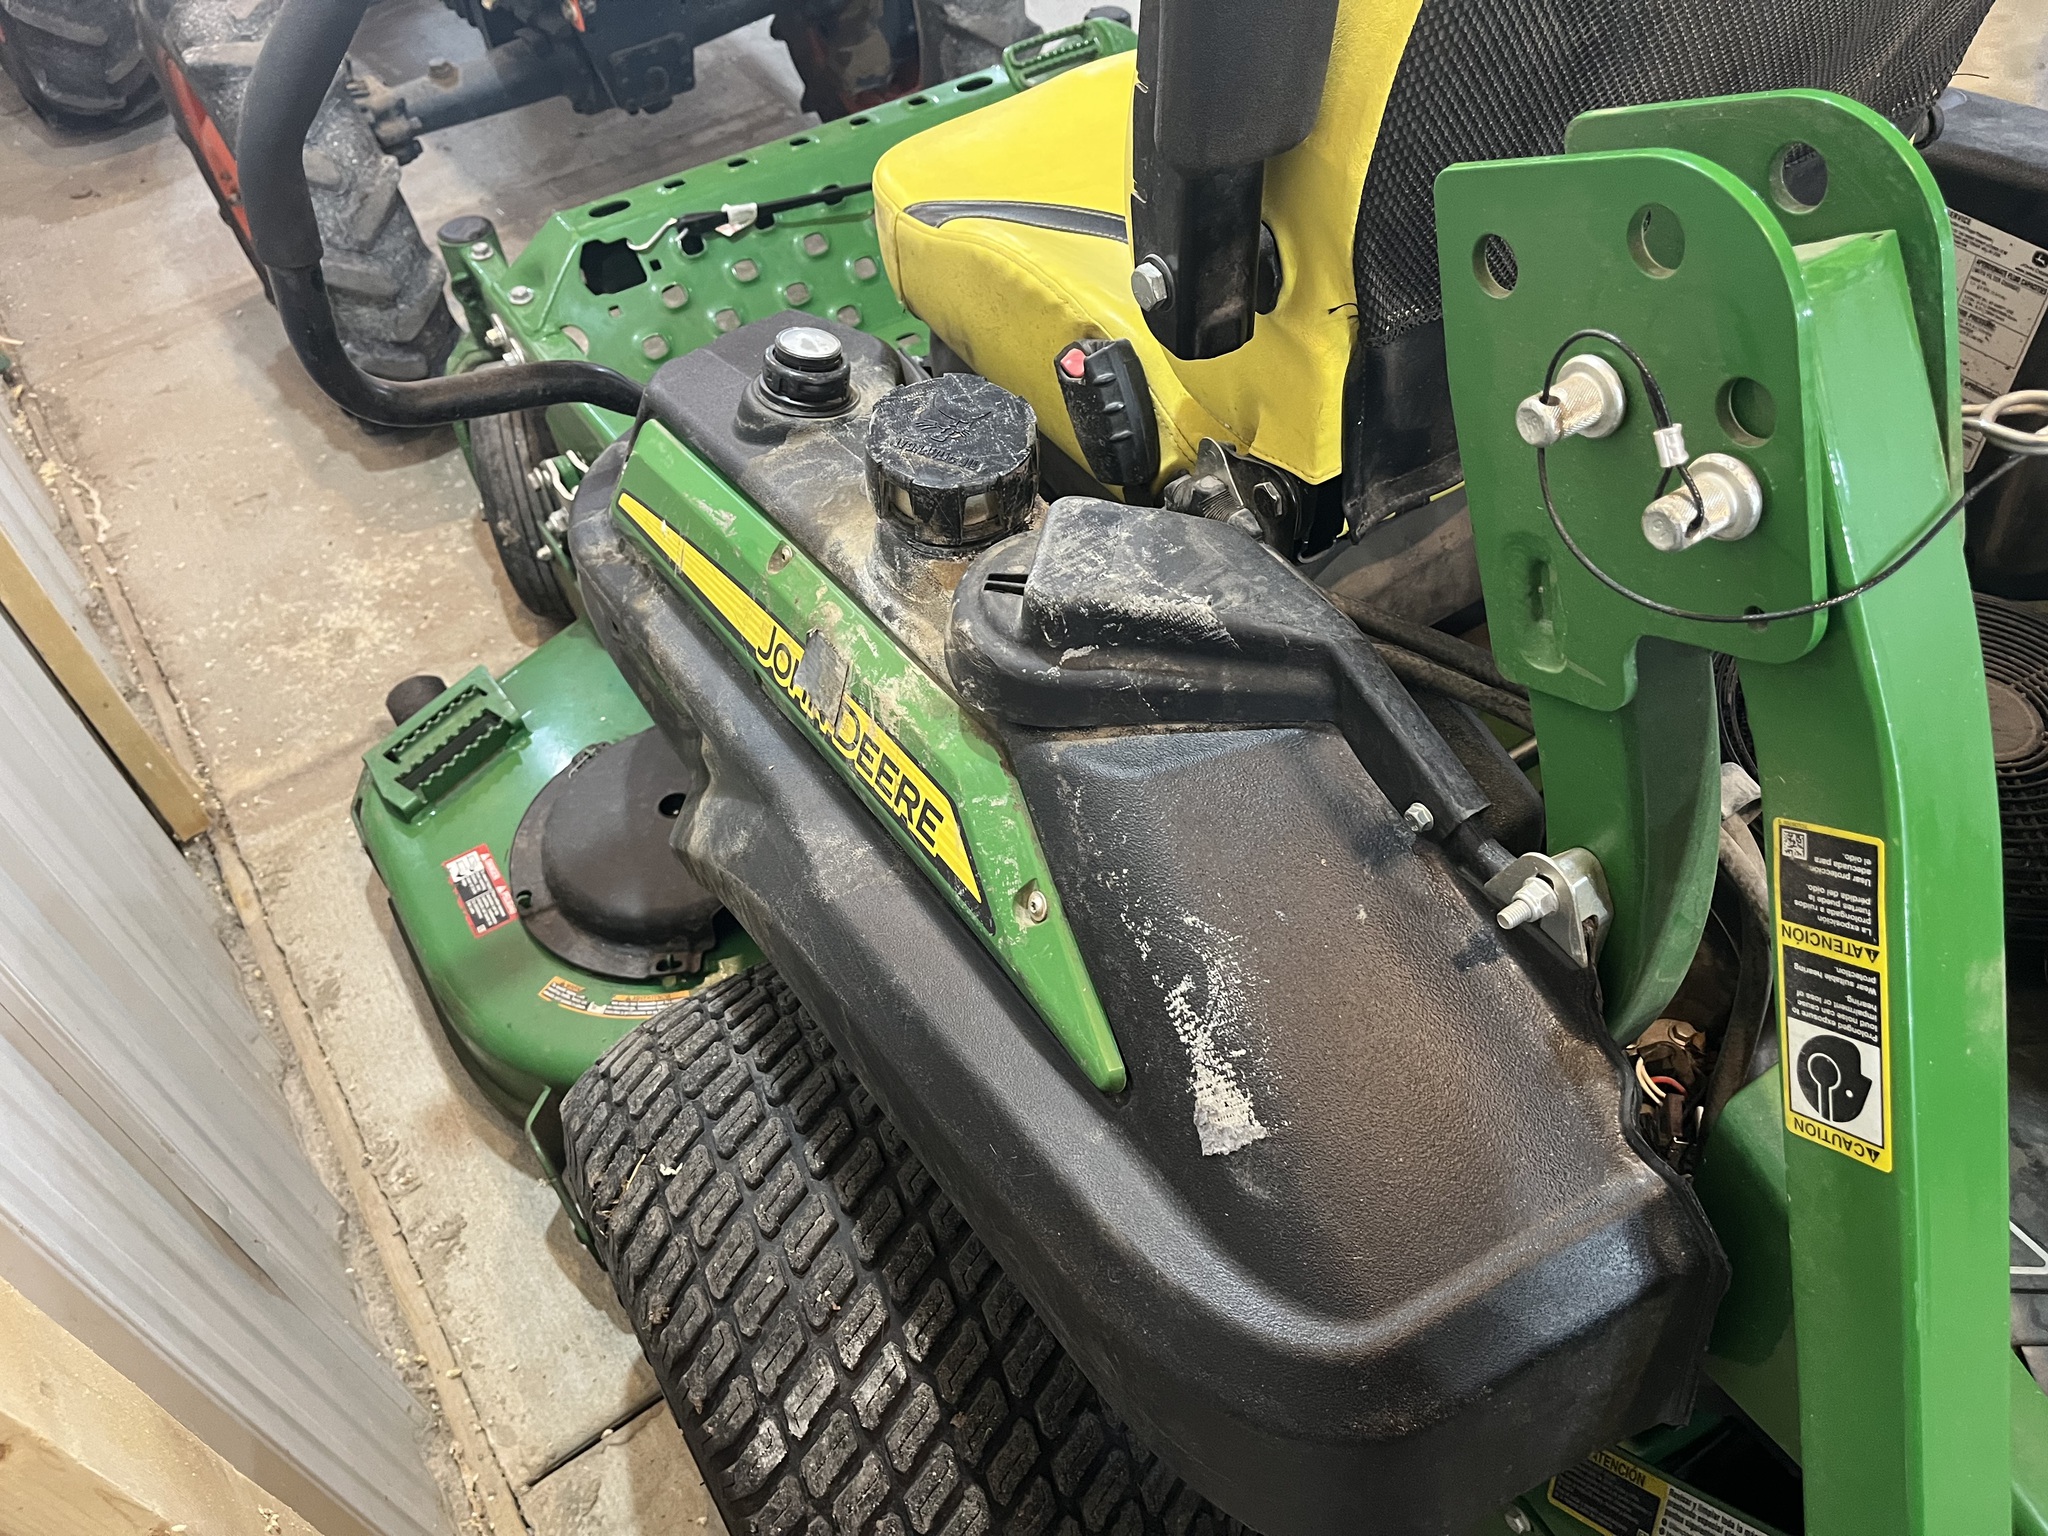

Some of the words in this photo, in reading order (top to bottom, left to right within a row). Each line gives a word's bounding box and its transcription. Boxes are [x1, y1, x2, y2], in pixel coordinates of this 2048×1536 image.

[834, 704, 945, 849] DEERE
[1814, 856, 1832, 866] para
[1864, 858, 1872, 866] el
[1833, 860, 1872, 876] adecuada
[1852, 876, 1872, 886] Usar
[1808, 894, 1815, 902] la
[1827, 889, 1839, 898] del
[1840, 891, 1872, 906] pérdida
[1794, 899, 1818, 912] ruidos
[1817, 896, 1840, 908] puede
[1843, 902, 1872, 916] fuertes
[1826, 908, 1872, 925] prolongada
[1817, 915, 1859, 932] exposición
[1861, 926, 1872, 936] La
[1782, 924, 1863, 958] ATENCIÓN
[1793, 962, 1823, 979] hearing
[1834, 966, 1877, 985] protection.
[1824, 973, 1854, 988] suitable
[1856, 983, 1877, 996] Wear
[1806, 993, 1822, 1003] loss
[1845, 995, 1877, 1011] hearing.
[1792, 1007, 1799, 1015] to
[1797, 1000, 1819, 1011] cause
[1821, 1007, 1835, 1016] can
[1833, 1001, 1877, 1021] impairment
[1801, 1010, 1836, 1027] exposure
[1836, 1012, 1858, 1023] noise
[1838, 1022, 1878, 1042] Prolonged
[1860, 1020, 1878, 1032] loud
[1794, 1119, 1866, 1158] CAUTION
